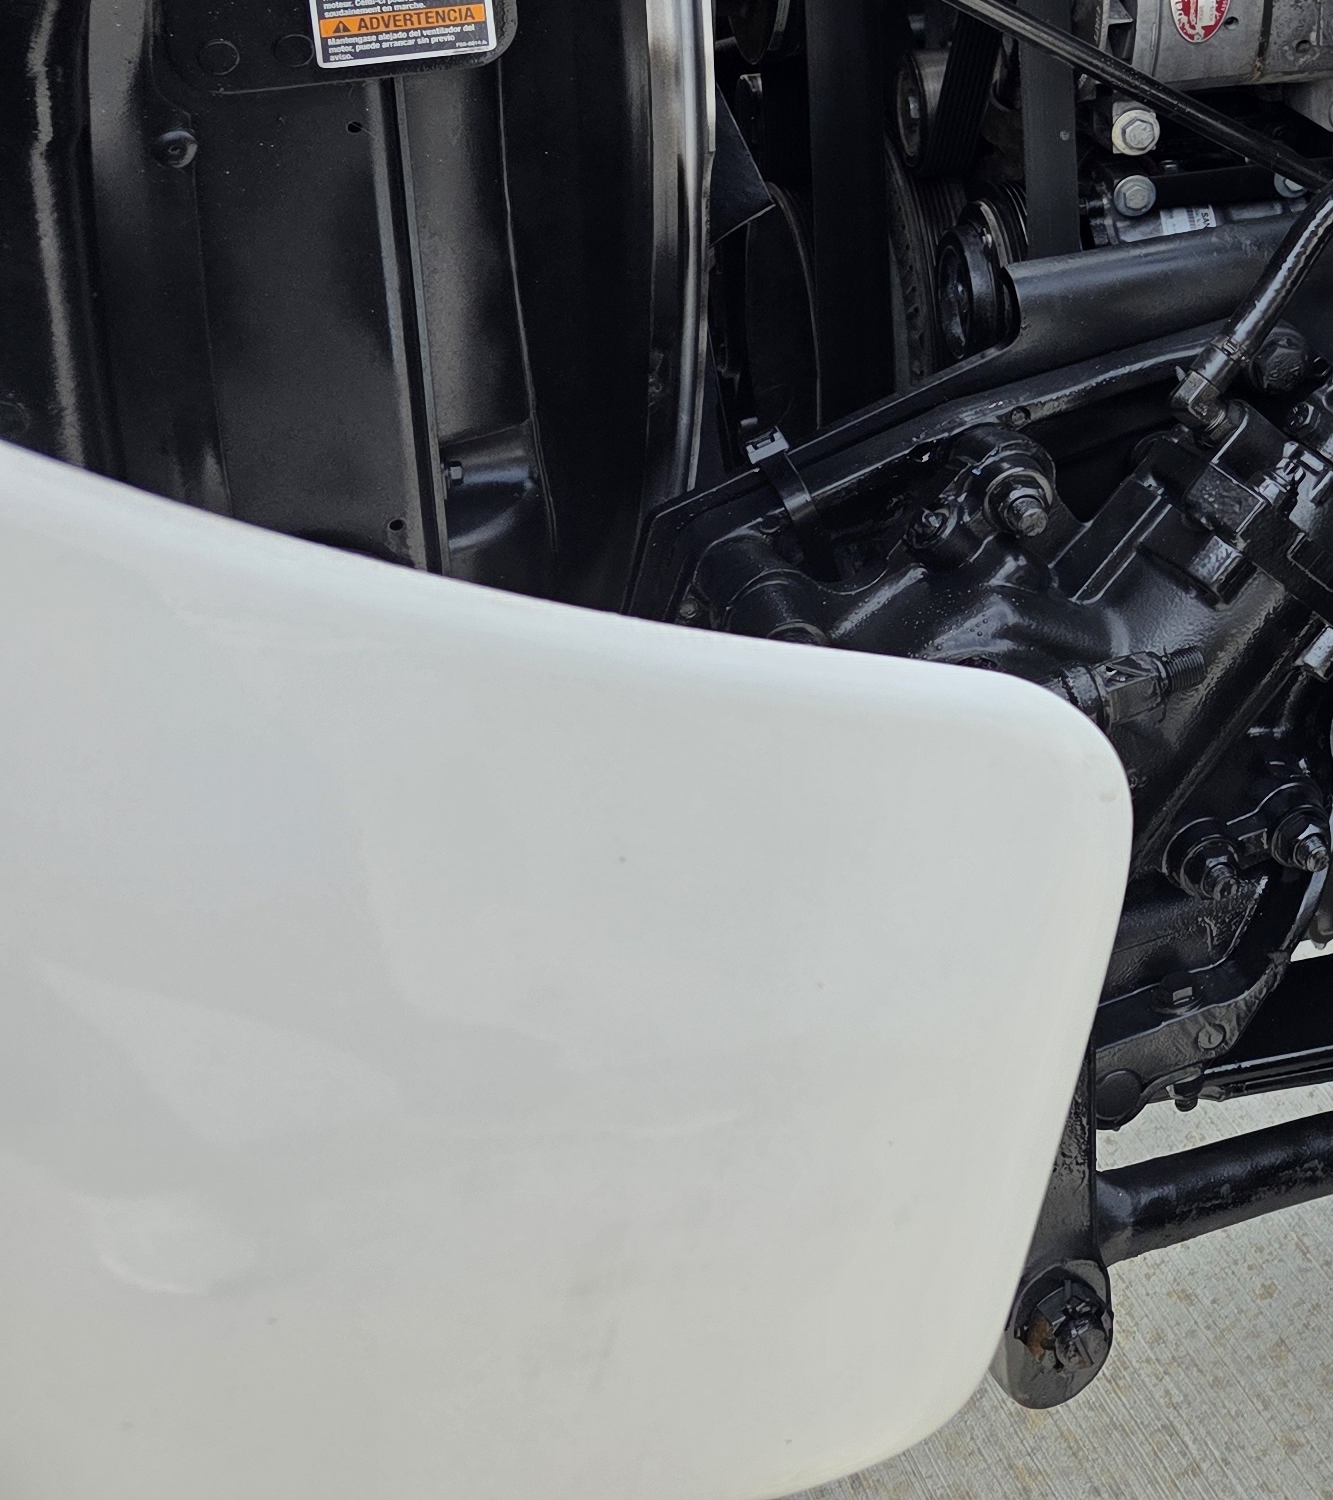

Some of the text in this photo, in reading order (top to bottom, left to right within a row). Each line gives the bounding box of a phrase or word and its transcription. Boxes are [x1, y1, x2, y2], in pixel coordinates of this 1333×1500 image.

[324, 2, 426, 18] soudainement en marche.
[357, 7, 476, 31] ADVERTENCIA
[328, 24, 475, 47] Mantengase alejado del ventilador del
[355, 41, 381, 52] puede
[382, 38, 416, 48] arrancar
[417, 36, 430, 45] sin
[431, 34, 455, 45] previo
[329, 52, 354, 62] aviso.
